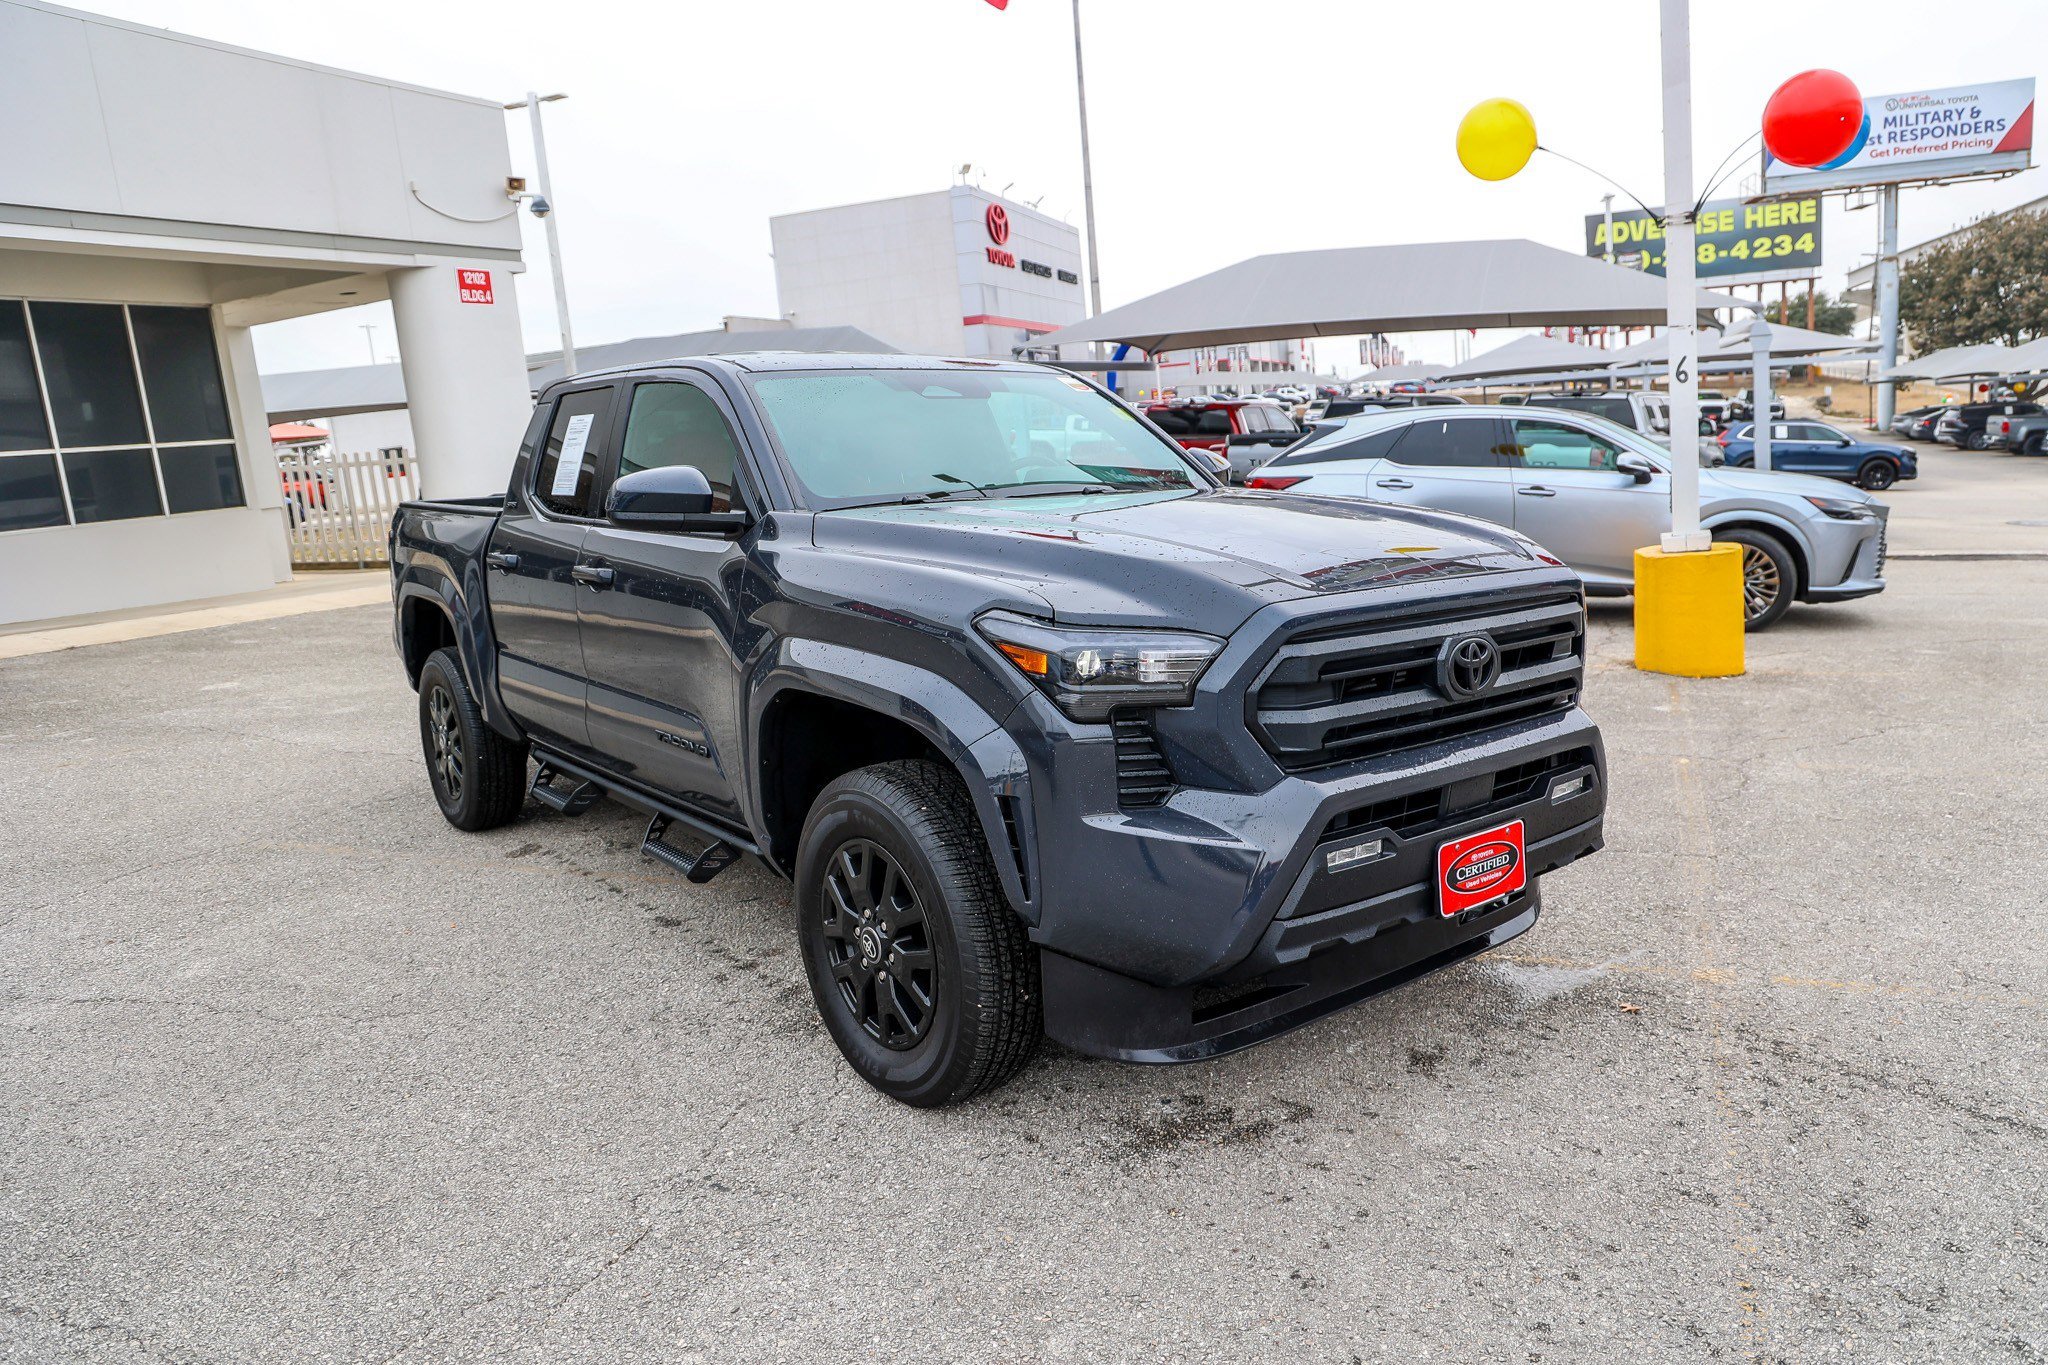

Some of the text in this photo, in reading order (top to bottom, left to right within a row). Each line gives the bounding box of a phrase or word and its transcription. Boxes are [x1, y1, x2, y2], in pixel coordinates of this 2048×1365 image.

[1900, 99, 1945, 110] UNIVERSAL
[1948, 94, 1979, 104] TOYOTA
[1883, 106, 1982, 129] MILITARY &
[1865, 118, 2006, 147] st RESPONDERS
[1870, 137, 1993, 158] Get Preferred Pricing
[1594, 200, 1817, 246] ADVEISE HERE
[986, 247, 1015, 268] TOYOTA
[463, 271, 486, 285] 12102
[1676, 355, 1688, 383] 6
[1477, 849, 1494, 858] TOYOTA
[1456, 854, 1509, 880] CERTIFIED
[1465, 871, 1502, 888] Used Vehicles
